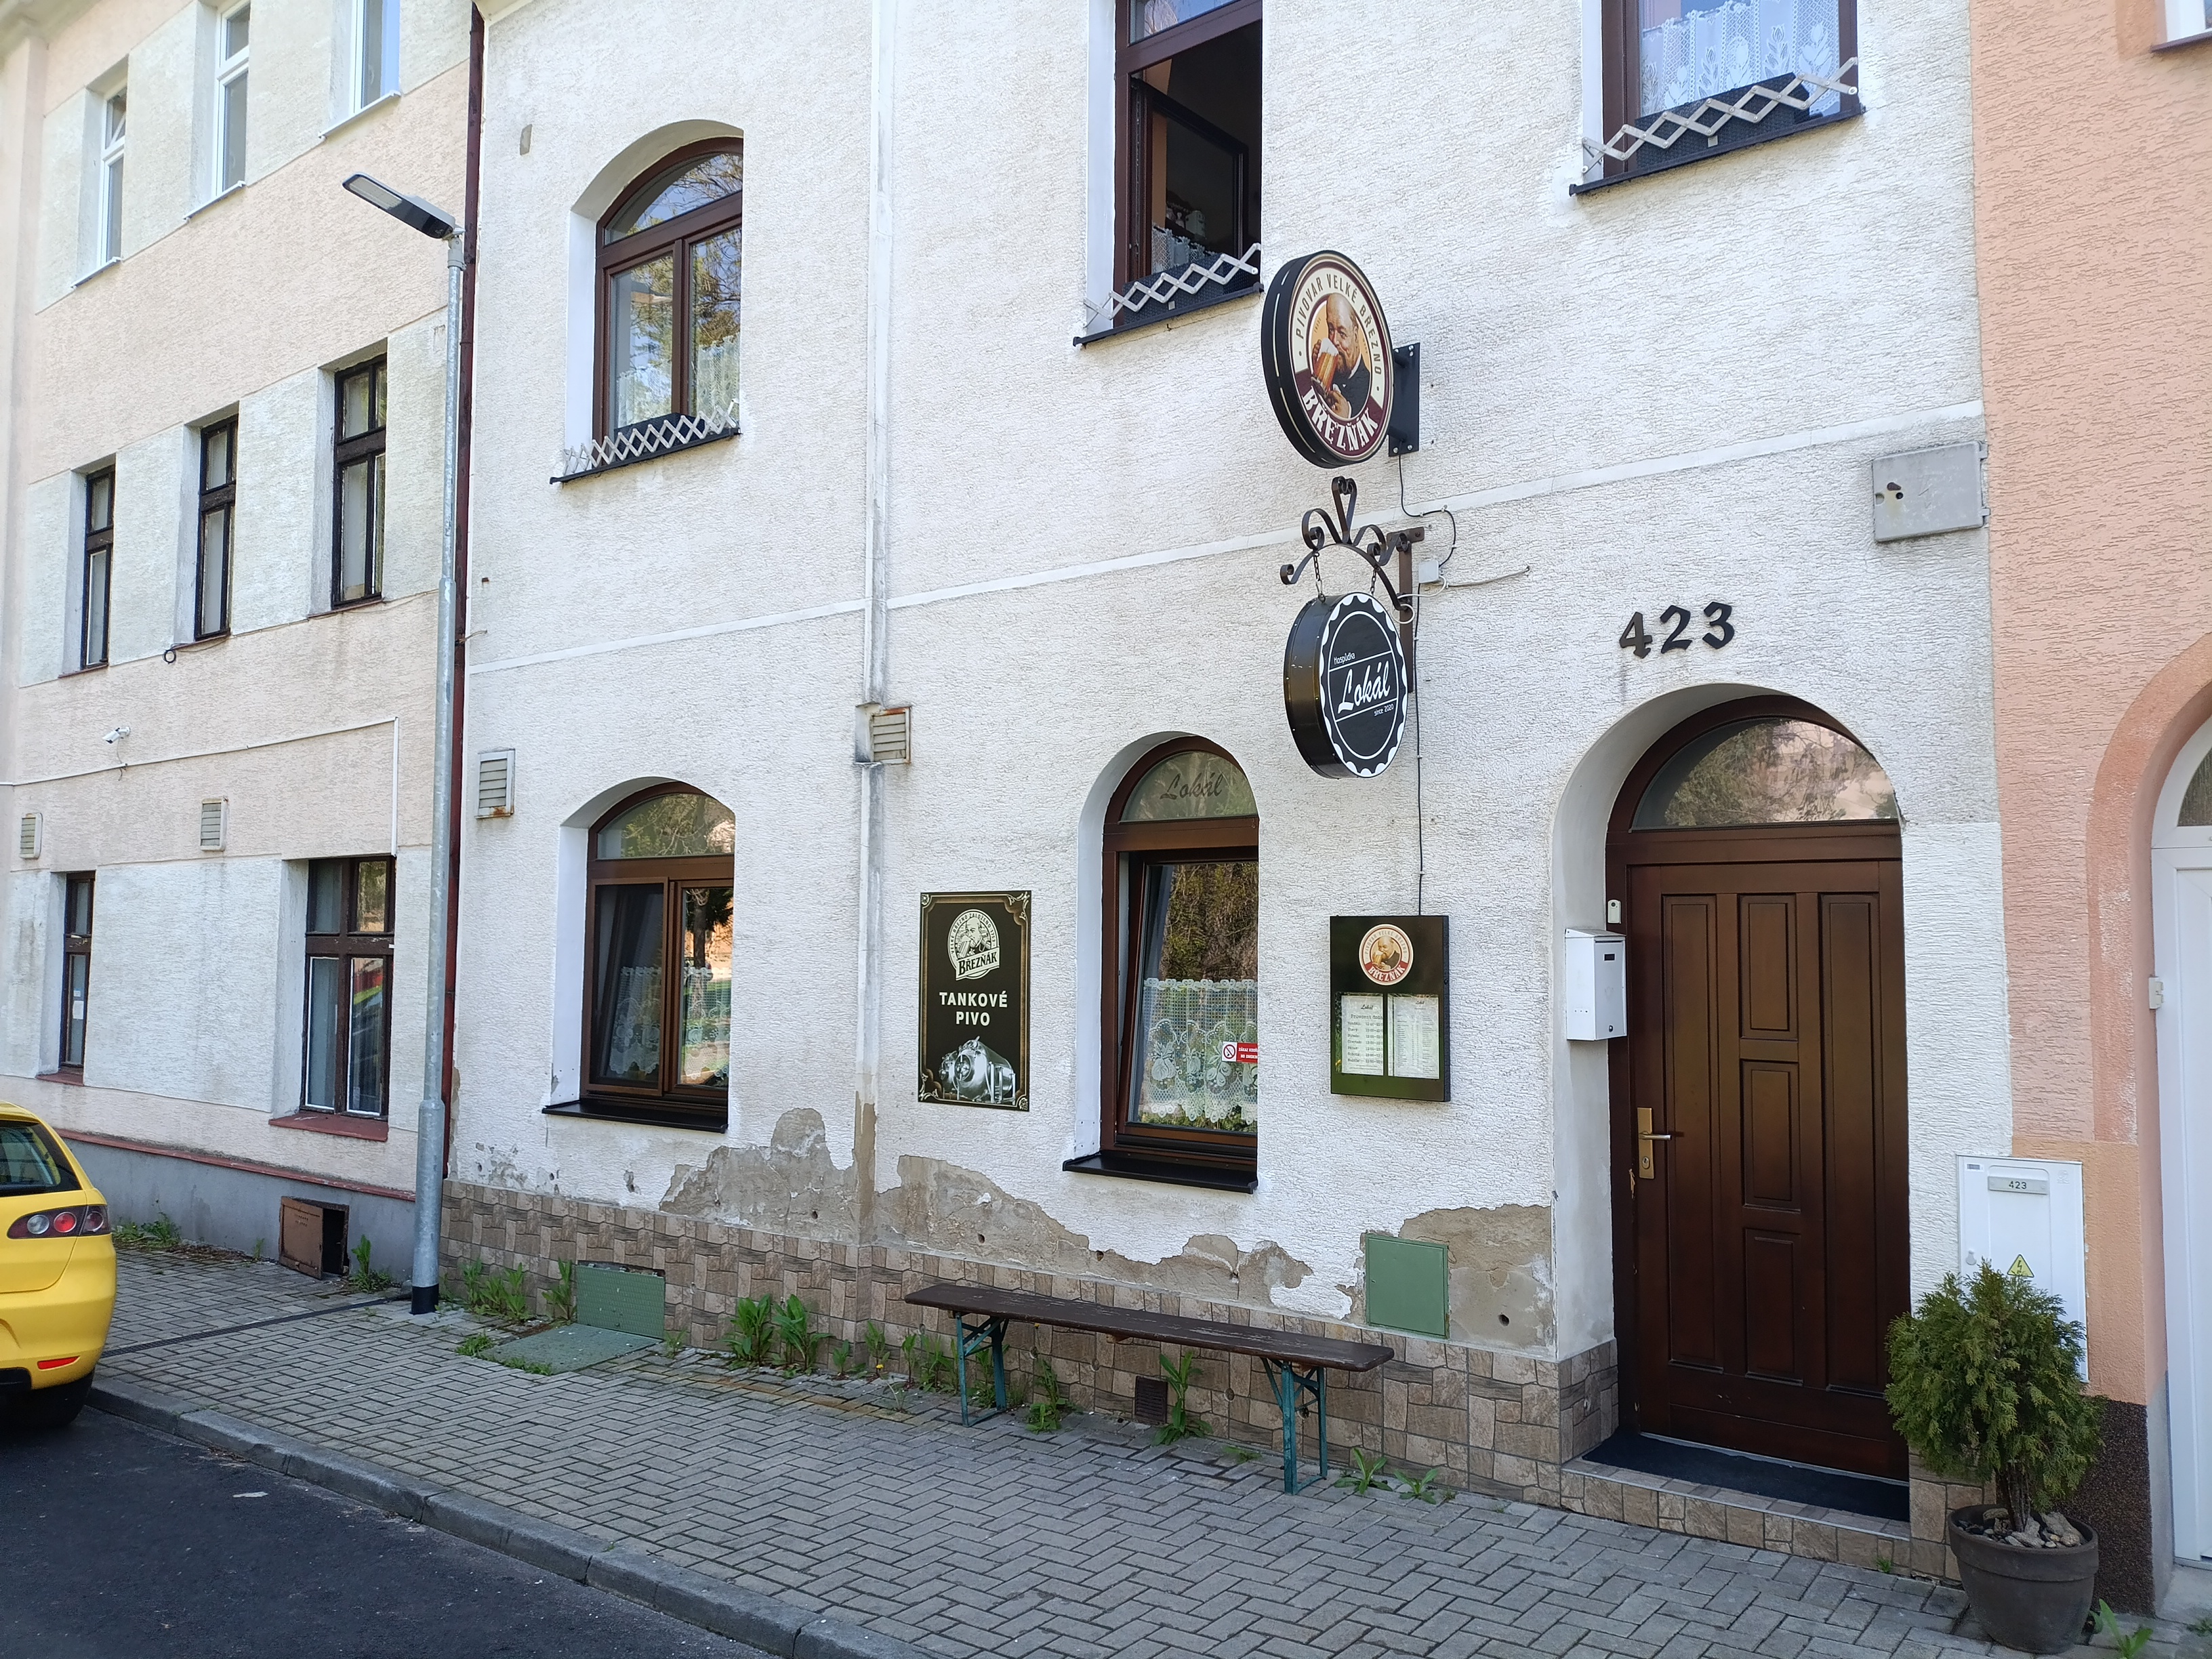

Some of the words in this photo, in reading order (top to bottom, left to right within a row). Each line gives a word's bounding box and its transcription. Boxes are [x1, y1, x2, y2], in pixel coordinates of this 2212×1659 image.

[1296, 277, 1323, 340] PIVOVAR
[1326, 274, 1357, 304] VELKÉ
[1359, 304, 1382, 375] BŘEZNO
[1619, 601, 1735, 659] 423
[1334, 652, 1355, 665] Hospůdka
[1338, 661, 1391, 714] Lokál
[1374, 708, 1383, 716] since
[1384, 703, 1394, 712] 2020
[1160, 772, 1224, 800] Lokál
[958, 951, 998, 977] BŘEZŇÁK
[939, 990, 1008, 1008] TANKOVÉ
[956, 1011, 990, 1026] PIVO
[2009, 1181, 2027, 1190] 423
